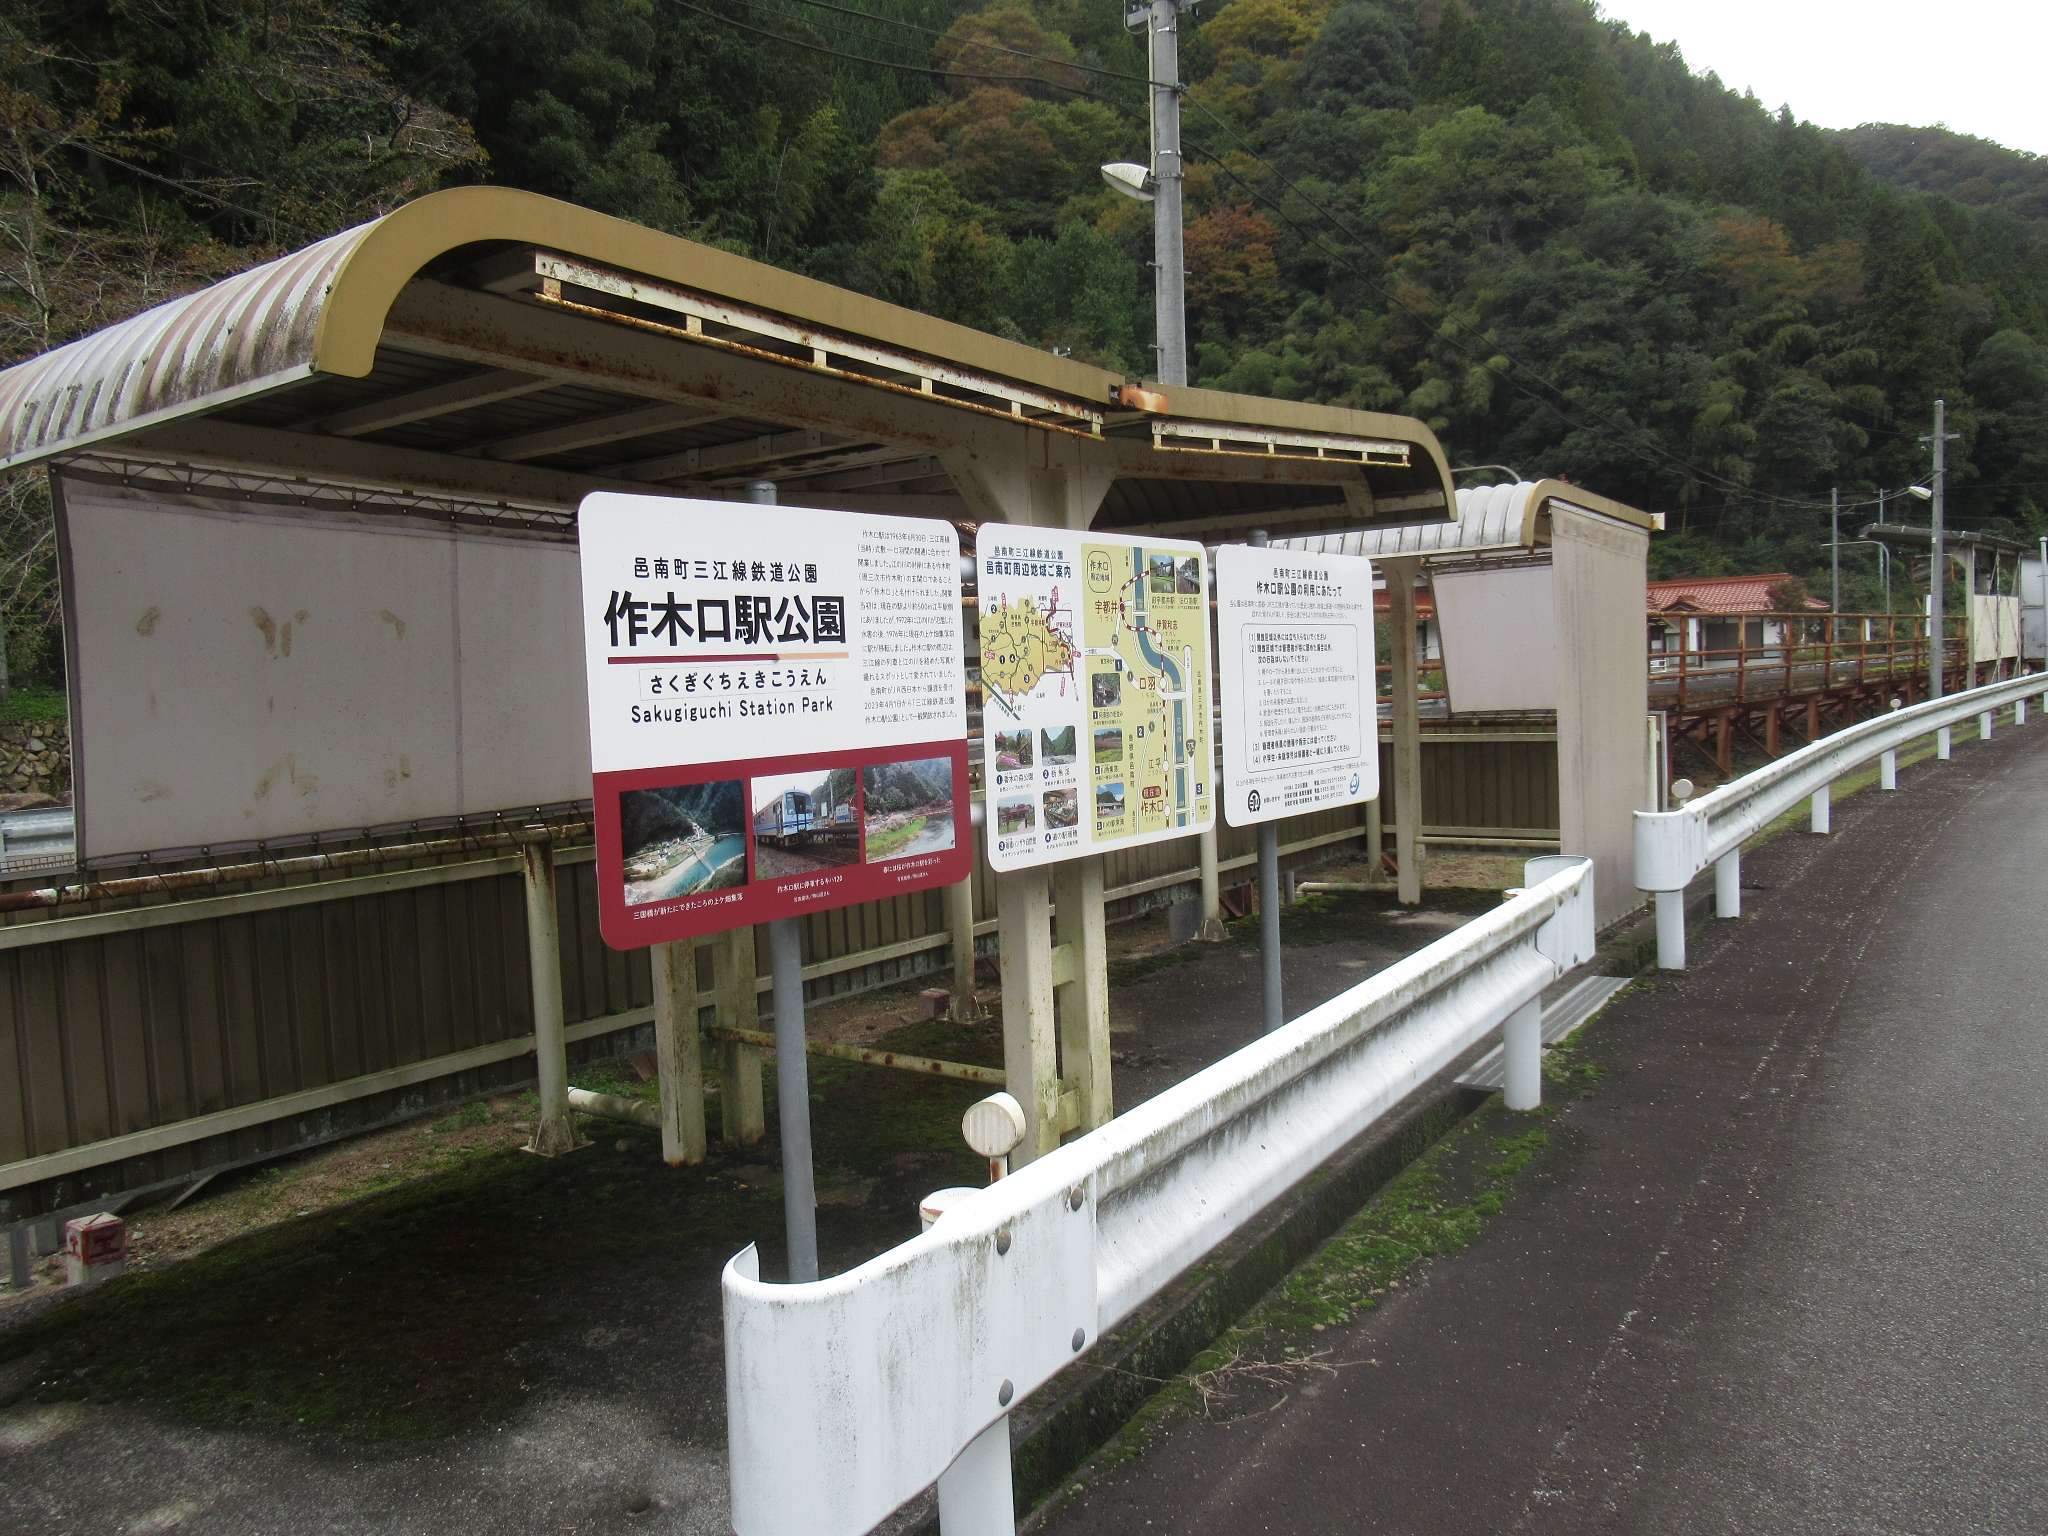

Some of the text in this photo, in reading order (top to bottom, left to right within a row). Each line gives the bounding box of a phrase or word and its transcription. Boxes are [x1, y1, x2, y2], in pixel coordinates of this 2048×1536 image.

[994, 545, 1064, 560] 邑南町三江線鉄道公園
[634, 556, 818, 583] 邑南町三江線鉄道公園
[986, 560, 1072, 579] 邑南町周辺地域ご案内
[1090, 561, 1109, 571] 作木口
[1273, 567, 1329, 581] 邑南町三江線鉄道公園
[1256, 581, 1343, 597] 作木口駅公園の利用にあたって
[1095, 601, 1118, 615] 宇都井
[603, 590, 847, 647] 作木口駅公園
[650, 668, 828, 693] さくぎぐちえきこうえん
[1139, 677, 1155, 690] 口羽
[631, 697, 833, 723] Sakugiguchi Station Park
[1141, 799, 1165, 817] 作木口
